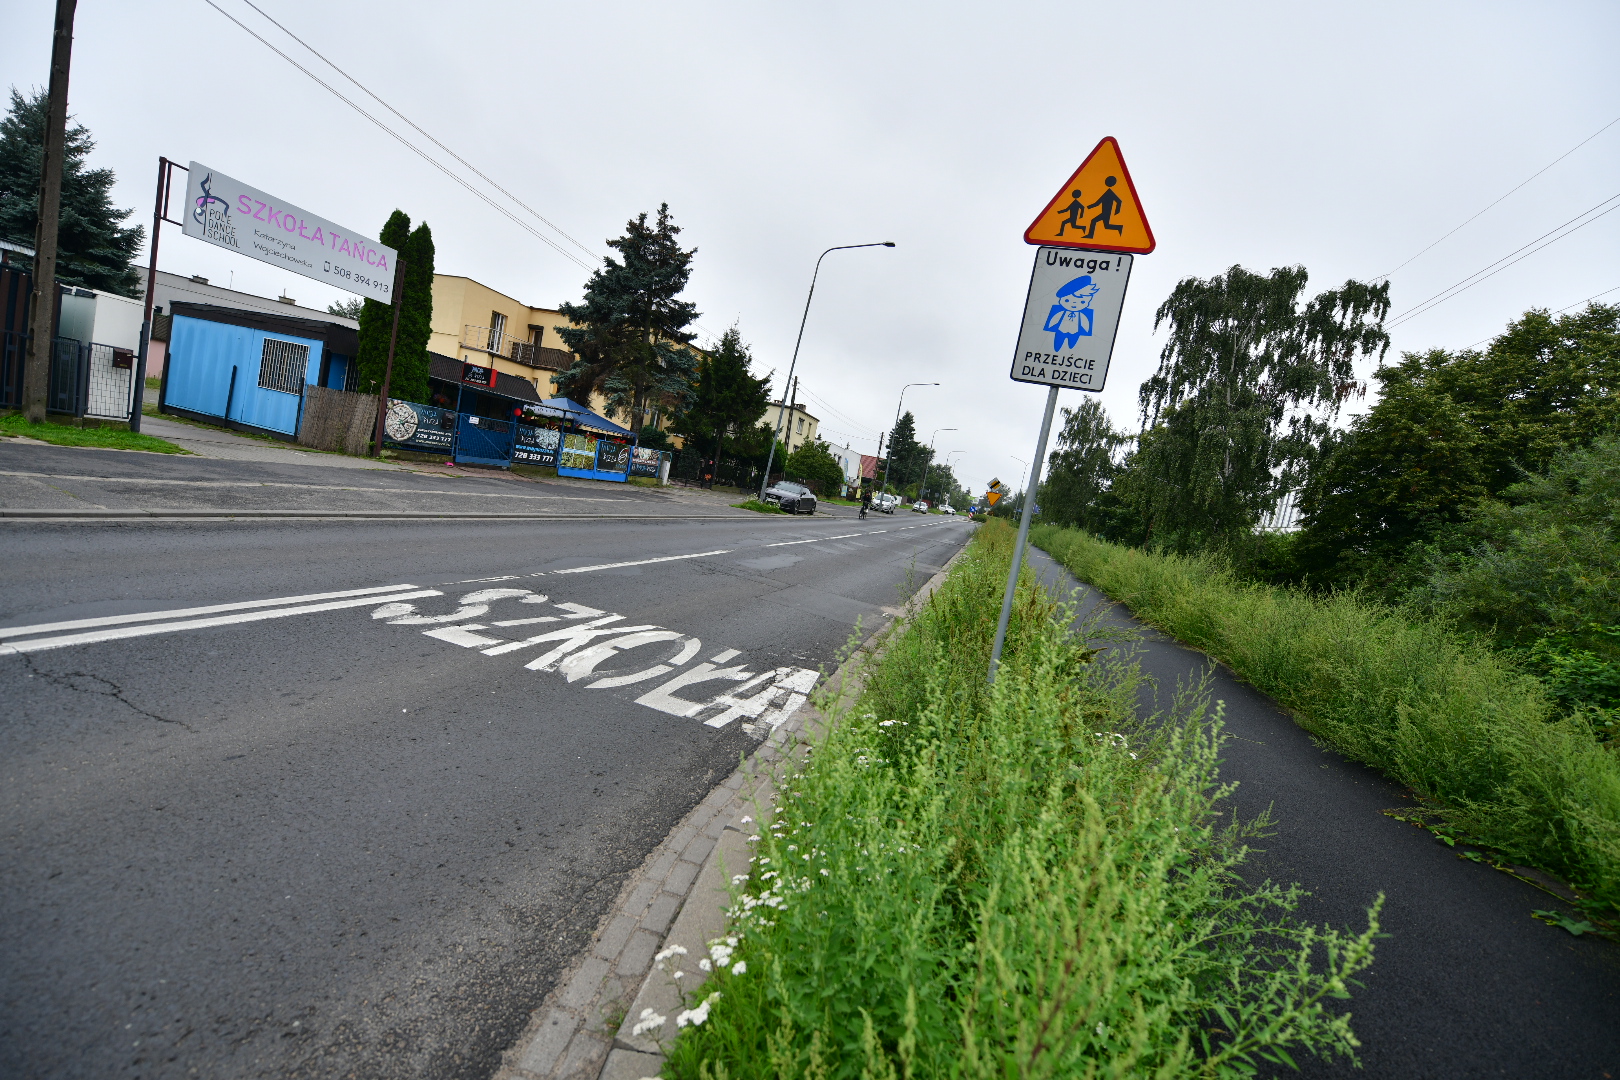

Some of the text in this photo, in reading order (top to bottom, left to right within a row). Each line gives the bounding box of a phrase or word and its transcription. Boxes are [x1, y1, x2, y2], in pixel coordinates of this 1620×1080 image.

[208, 218, 236, 236] DANCE
[209, 208, 232, 226] POLE
[207, 228, 240, 249] SCHOOL
[236, 194, 388, 271] SZKOŁA TAŃCA
[254, 228, 296, 251] Katarzyna
[253, 241, 313, 269] Wojciechowska
[1046, 251, 1111, 274] Uwaga
[333, 265, 389, 293] 508 394 913
[1024, 351, 1096, 371] PRZEJŚCIE
[1021, 366, 1093, 385] DLA DZIECI
[514, 451, 528, 459] 728
[528, 453, 541, 461] 333
[371, 588, 820, 734] SZKOŁA
